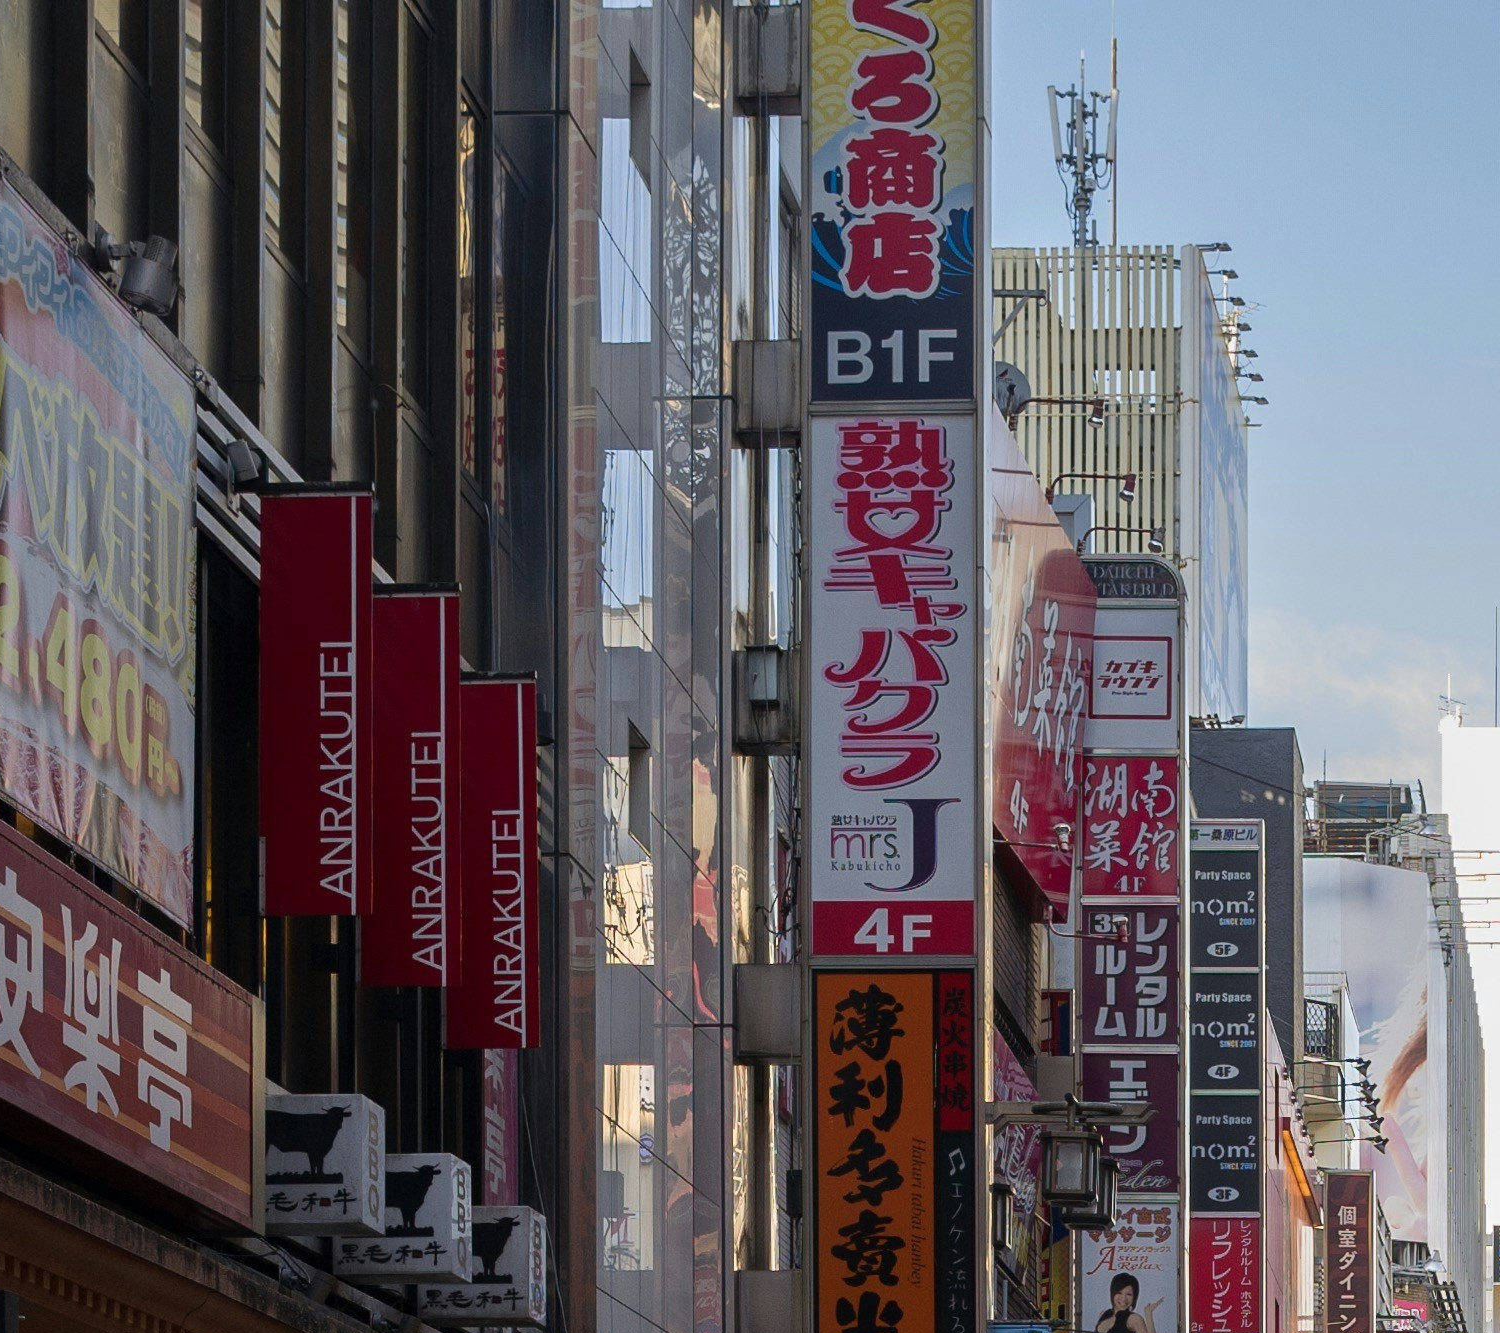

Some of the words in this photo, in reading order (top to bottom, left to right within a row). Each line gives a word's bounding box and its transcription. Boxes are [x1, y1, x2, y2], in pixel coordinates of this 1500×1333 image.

[827, 329, 959, 385] B1F
[821, 416, 968, 790] 熟女キャバクラ
[1096, 674, 1164, 689] ラウンジ
[1105, 659, 1158, 674] カブキ
[318, 639, 352, 902] ANRAKUTEI
[1084, 761, 1176, 819] 湖南
[411, 730, 444, 972] ANRAKUTEI
[830, 860, 902, 872] Kabukicho
[1084, 819, 1178, 874] 菜館
[1113, 876, 1147, 893] 4F
[1195, 870, 1220, 881] Party
[1221, 870, 1252, 881] Space
[493, 808, 525, 1034] ANRAKUTEI
[852, 913, 934, 955] 4F
[1094, 944, 1129, 1038] ルーム
[1134, 912, 1168, 1038] レンタル
[1195, 992, 1220, 1003] Party
[1221, 992, 1252, 1003] Space
[1195, 1115, 1220, 1126] Party
[1221, 1115, 1252, 1126] Space
[368, 1109, 379, 1224] BBQ
[456, 1168, 467, 1270] BBQ
[338, 1241, 448, 1266] 黒毛和牛
[1211, 1221, 1232, 1333] リフレッシュ
[1239, 1220, 1253, 1286] レンタルルーム
[422, 1287, 524, 1311] 黒毛和牛
